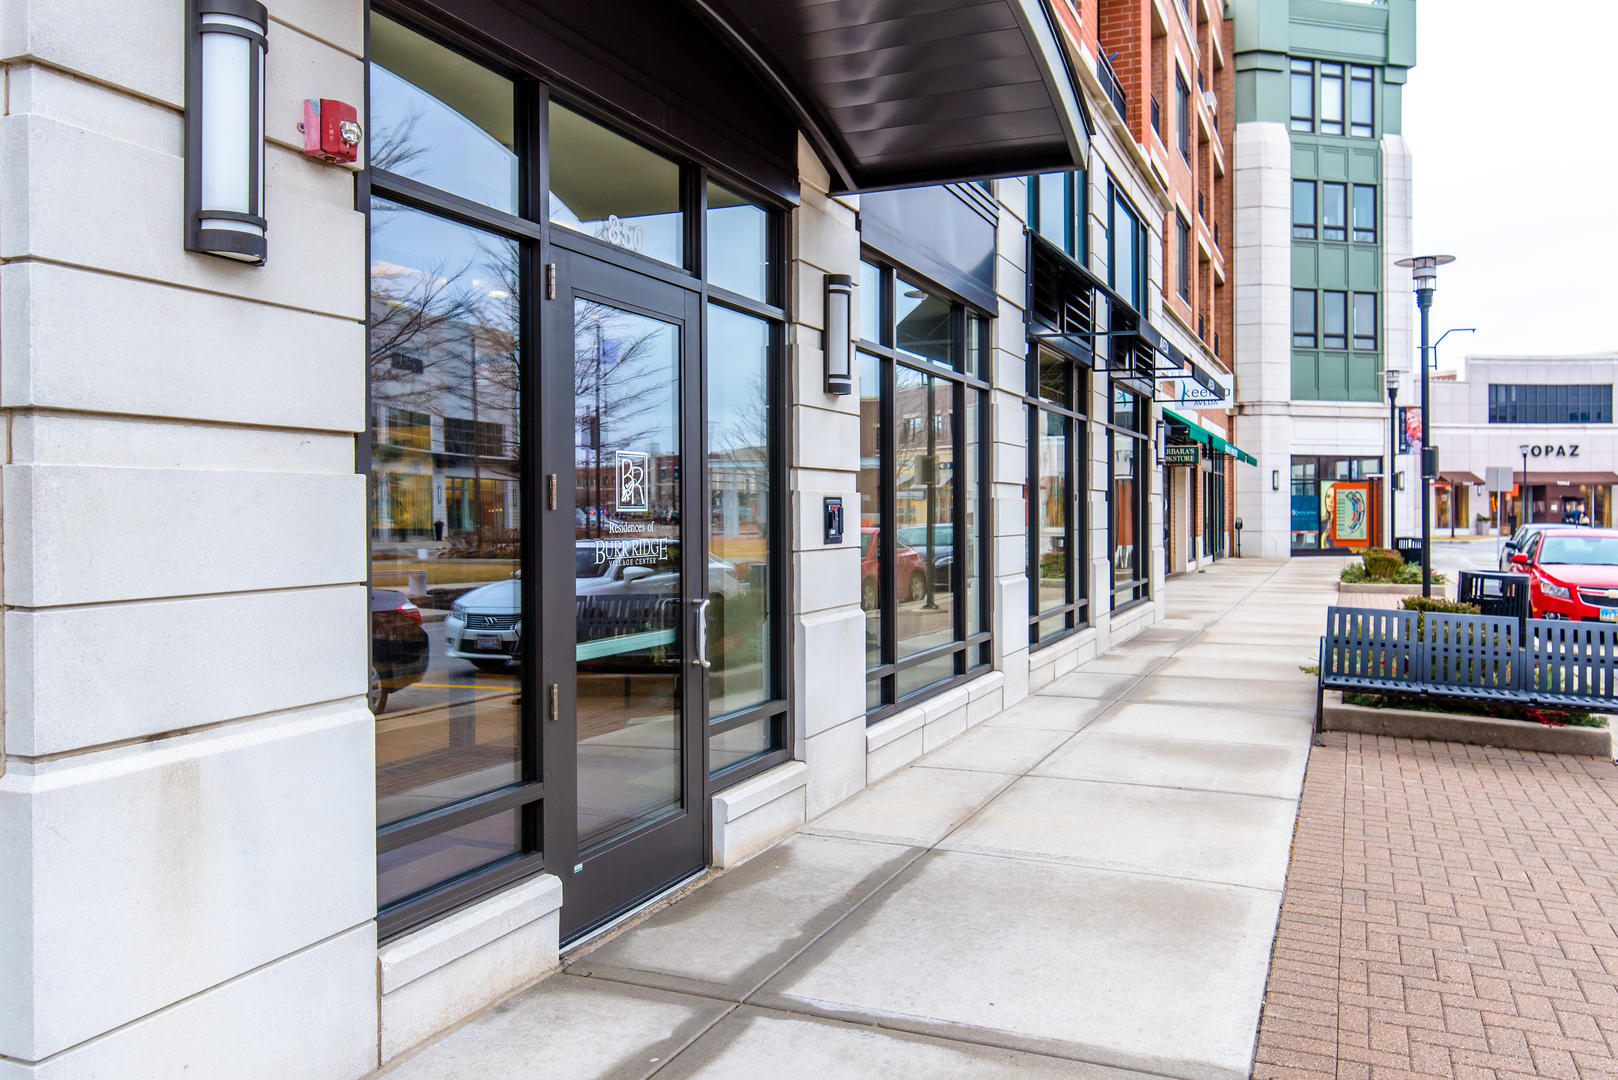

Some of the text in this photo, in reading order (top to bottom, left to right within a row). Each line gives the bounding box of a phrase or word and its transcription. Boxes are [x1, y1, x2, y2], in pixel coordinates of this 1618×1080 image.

[608, 214, 647, 253] 850
[1530, 445, 1580, 457] OPAZ
[609, 521, 655, 534] Residences of
[594, 537, 668, 564] BURR RIDGE
[609, 557, 657, 567] VILLAGE CENTER
